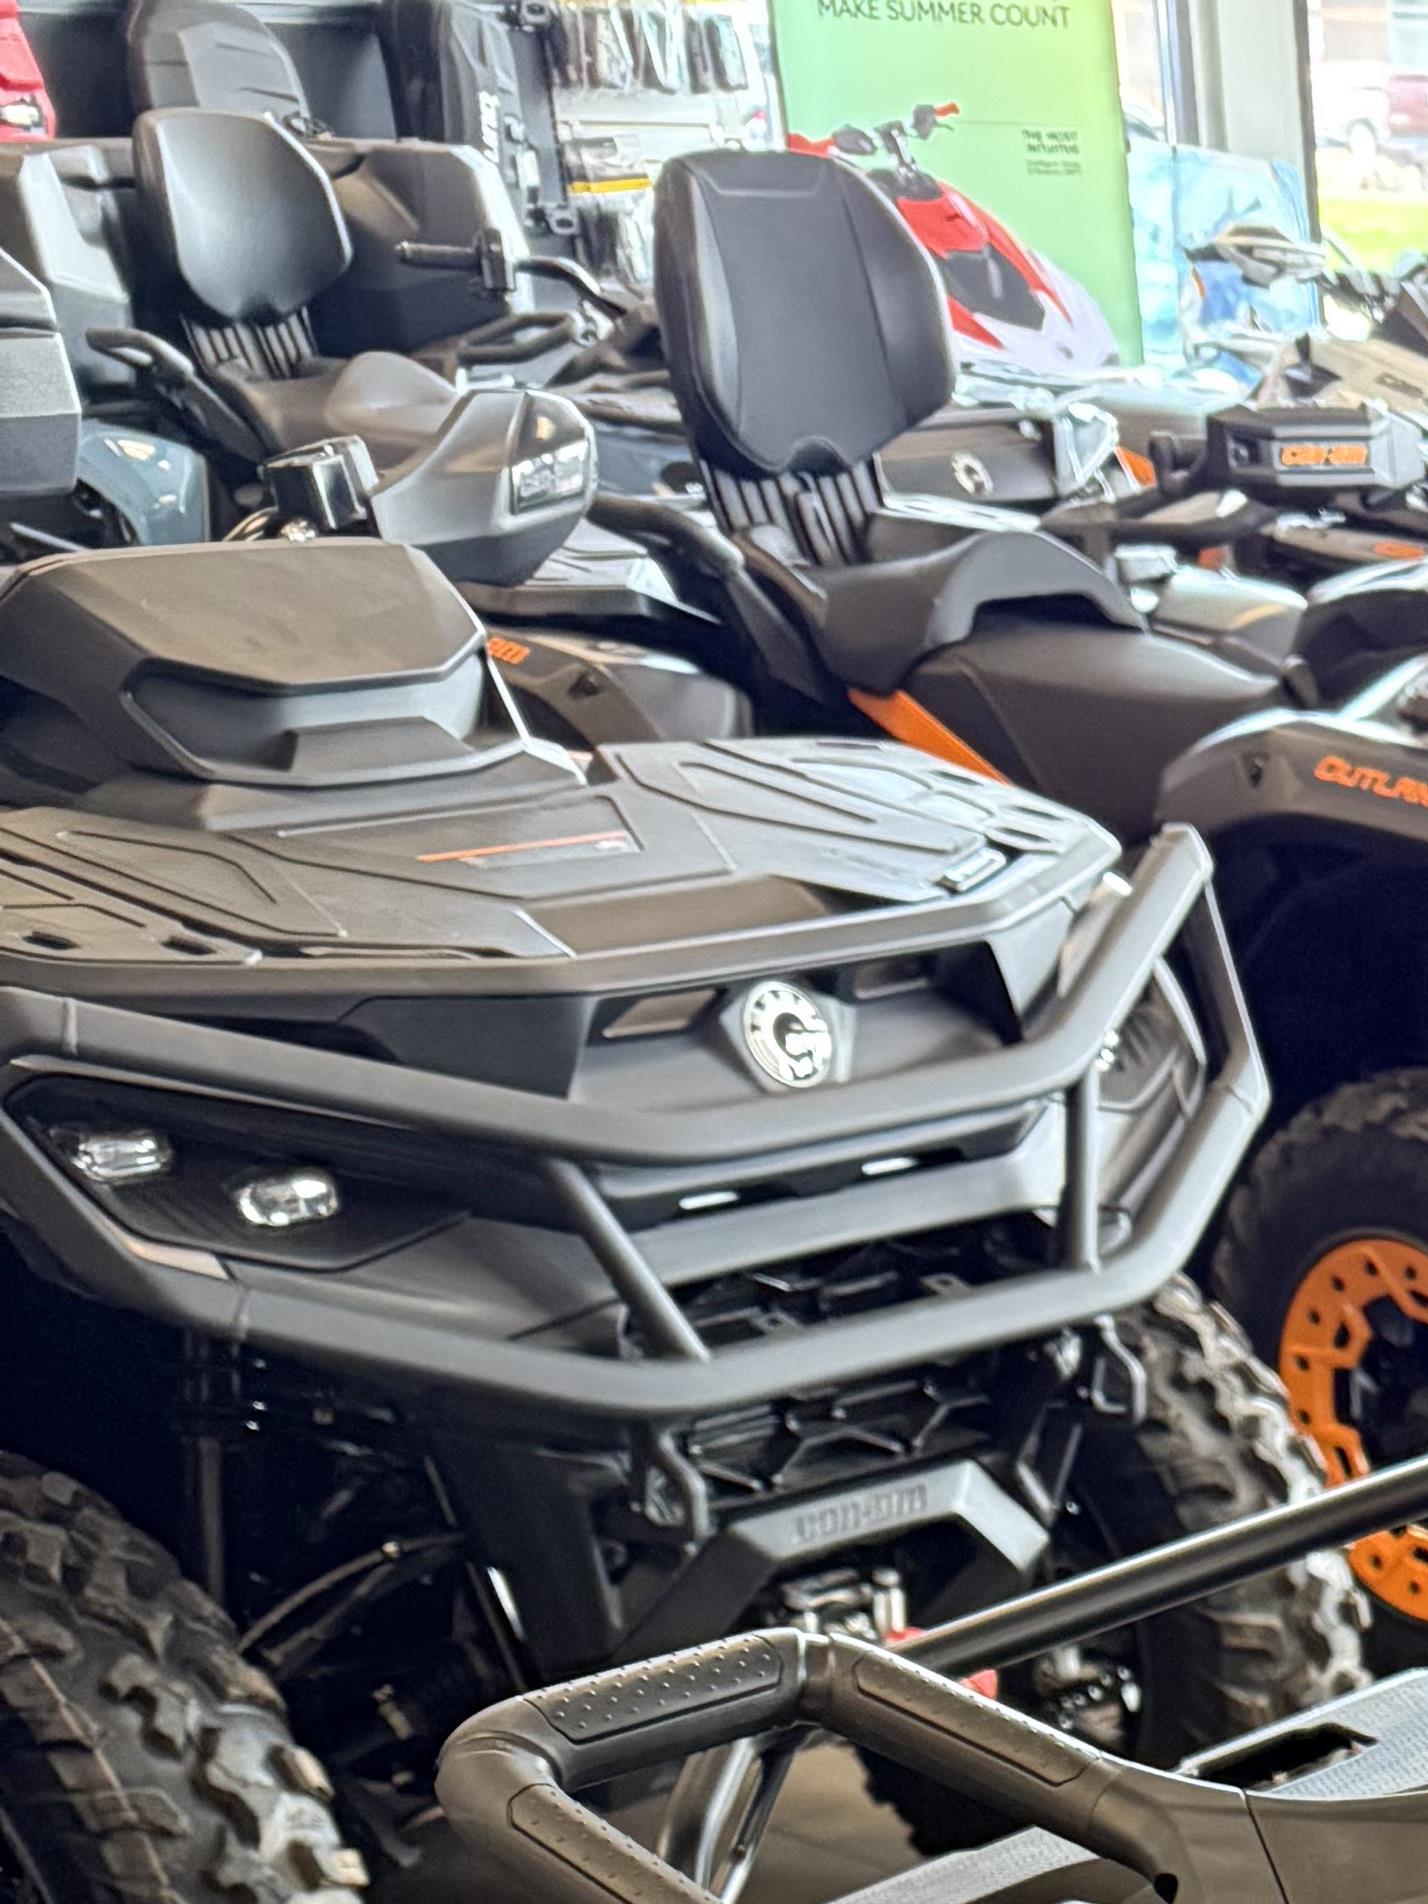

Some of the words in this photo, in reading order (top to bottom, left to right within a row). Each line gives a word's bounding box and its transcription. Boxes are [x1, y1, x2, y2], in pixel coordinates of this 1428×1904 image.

[816, 0, 881, 19] MAKE
[887, 0, 985, 24] SUMMER
[989, 4, 1071, 28] COUNT
